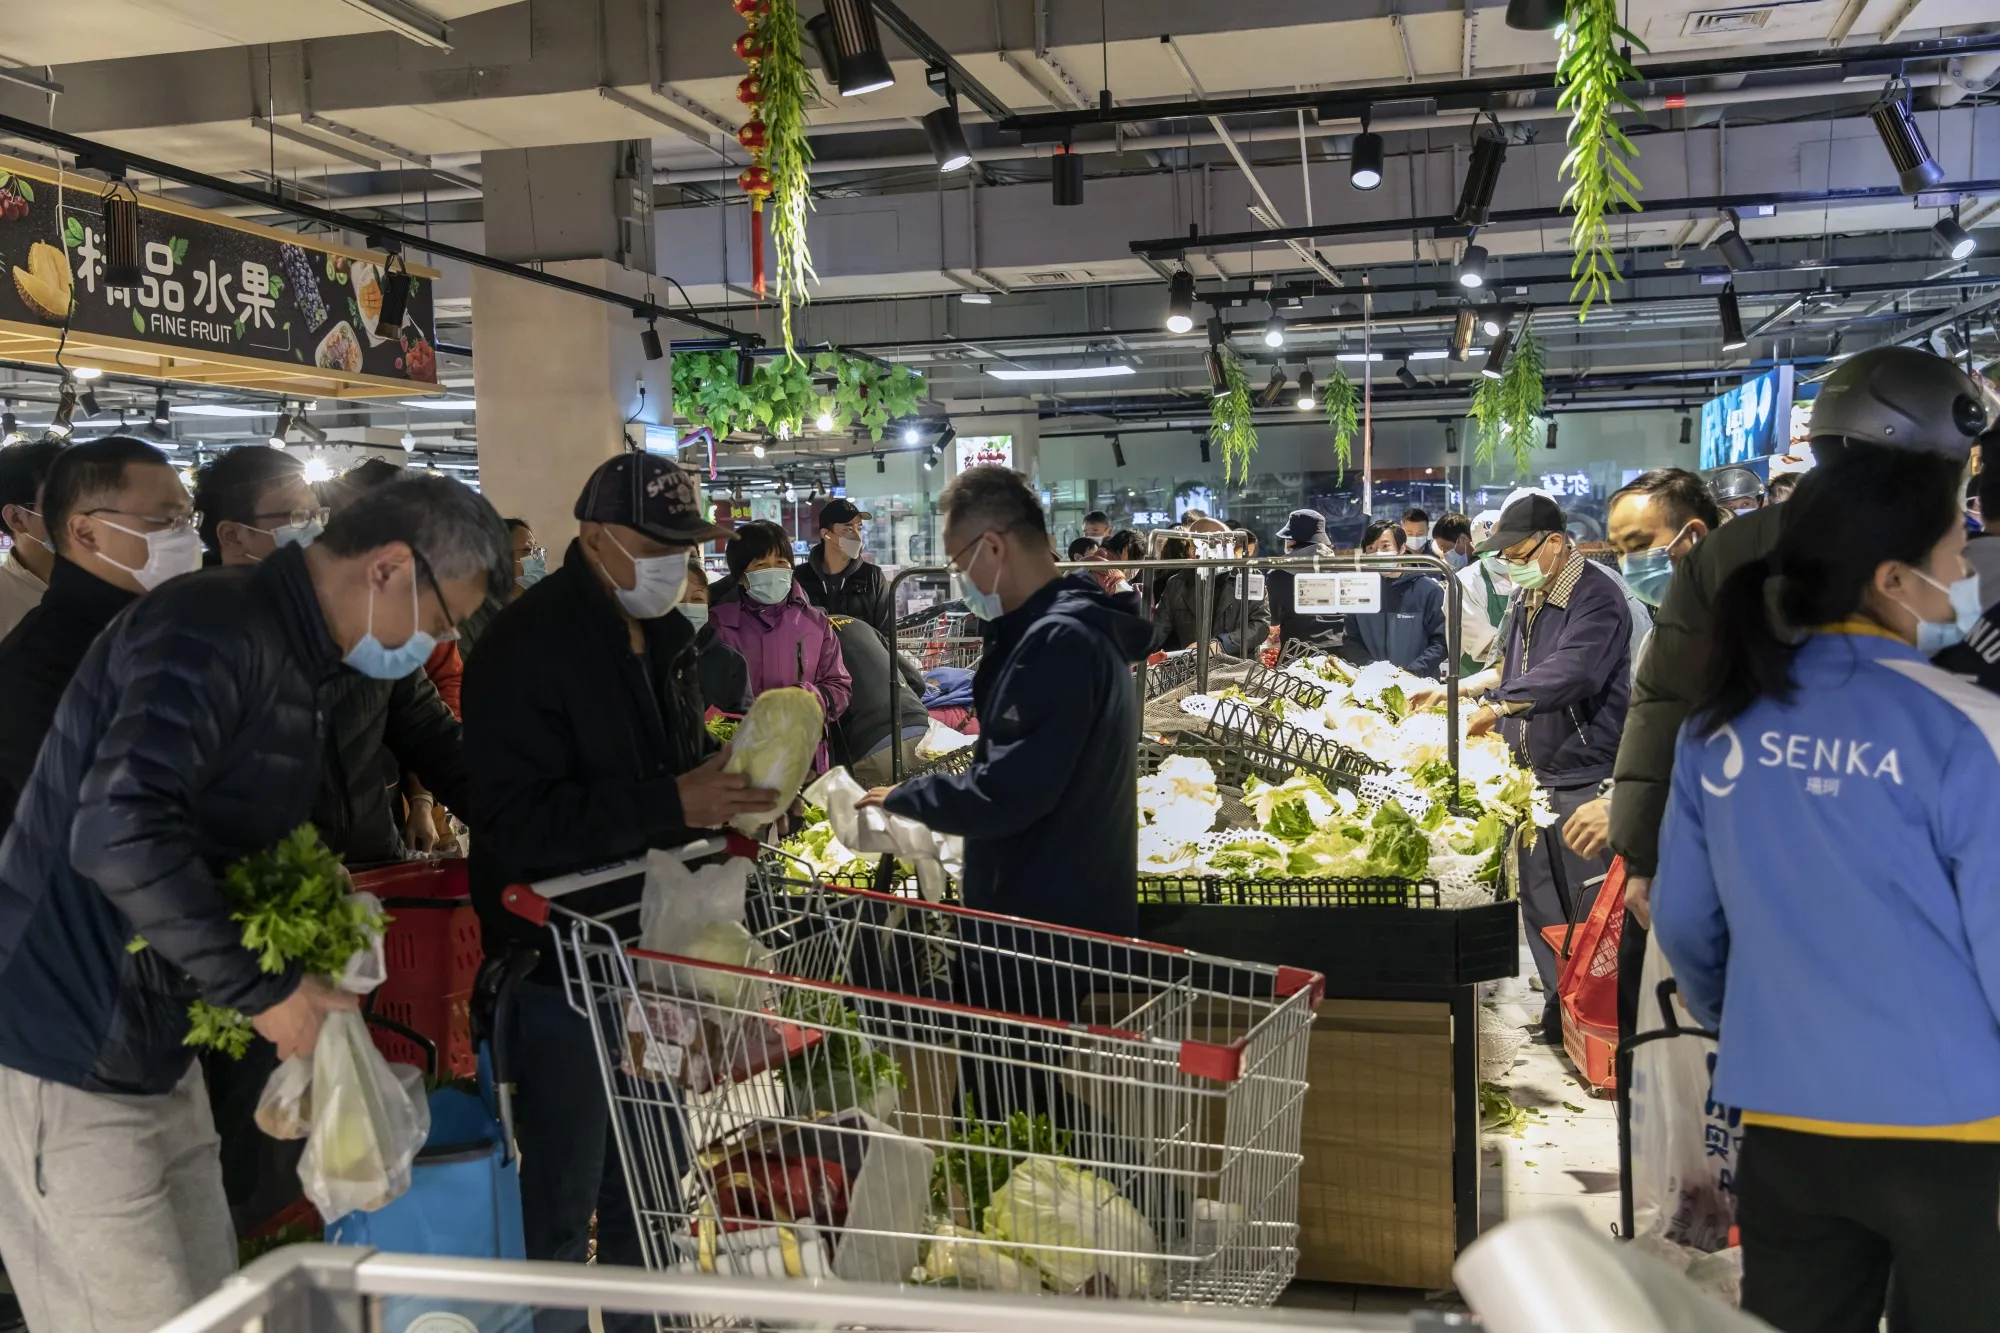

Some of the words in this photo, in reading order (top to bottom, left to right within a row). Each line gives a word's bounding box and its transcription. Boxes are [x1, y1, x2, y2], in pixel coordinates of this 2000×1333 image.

[150, 312, 187, 338] FINE
[190, 319, 232, 345] FRUIT
[1758, 731, 1904, 786] SENKA
